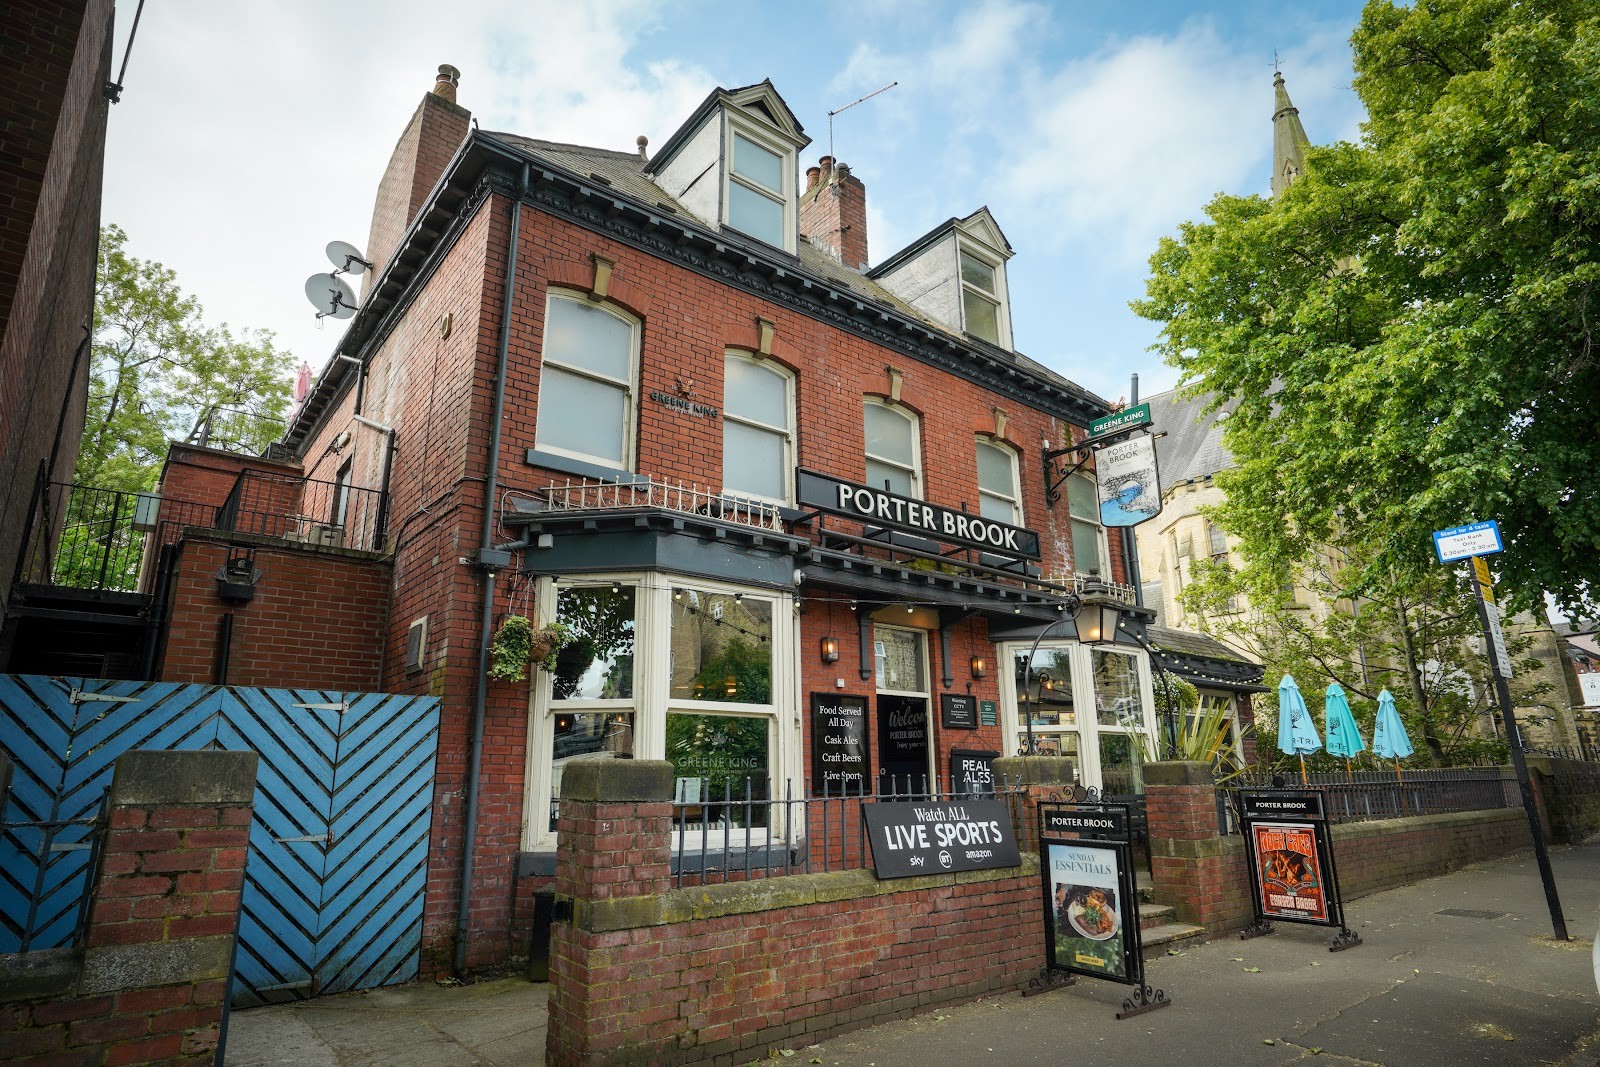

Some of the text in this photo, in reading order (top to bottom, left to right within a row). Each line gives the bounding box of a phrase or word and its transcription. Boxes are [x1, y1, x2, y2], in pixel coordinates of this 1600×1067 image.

[651, 392, 690, 410] GREENE
[693, 403, 718, 418] KING
[1093, 418, 1123, 432] GREENE
[1124, 410, 1144, 422] KING
[1107, 442, 1139, 456] PORTER
[1109, 449, 1139, 464] BROOK
[839, 483, 1020, 551] PORTER BROOK
[1440, 529, 1457, 537] Stand
[819, 705, 862, 716] Food Served
[828, 717, 854, 729] All Day
[824, 735, 859, 745] Cask Ales
[678, 756, 758, 768] GREENE KING
[822, 752, 861, 763] Craft Beers
[962, 759, 991, 772] REAL
[823, 771, 841, 780] Live
[962, 771, 991, 784] ALES
[914, 806, 970, 823] Watch ALL
[1051, 816, 1114, 829] PORTER BROOK
[884, 820, 1003, 850] LIVE SPORTS
[909, 849, 993, 867] sky BT amazon
[1068, 853, 1096, 862] SUNDAY
[1055, 860, 1112, 875] ESSENTIALS
